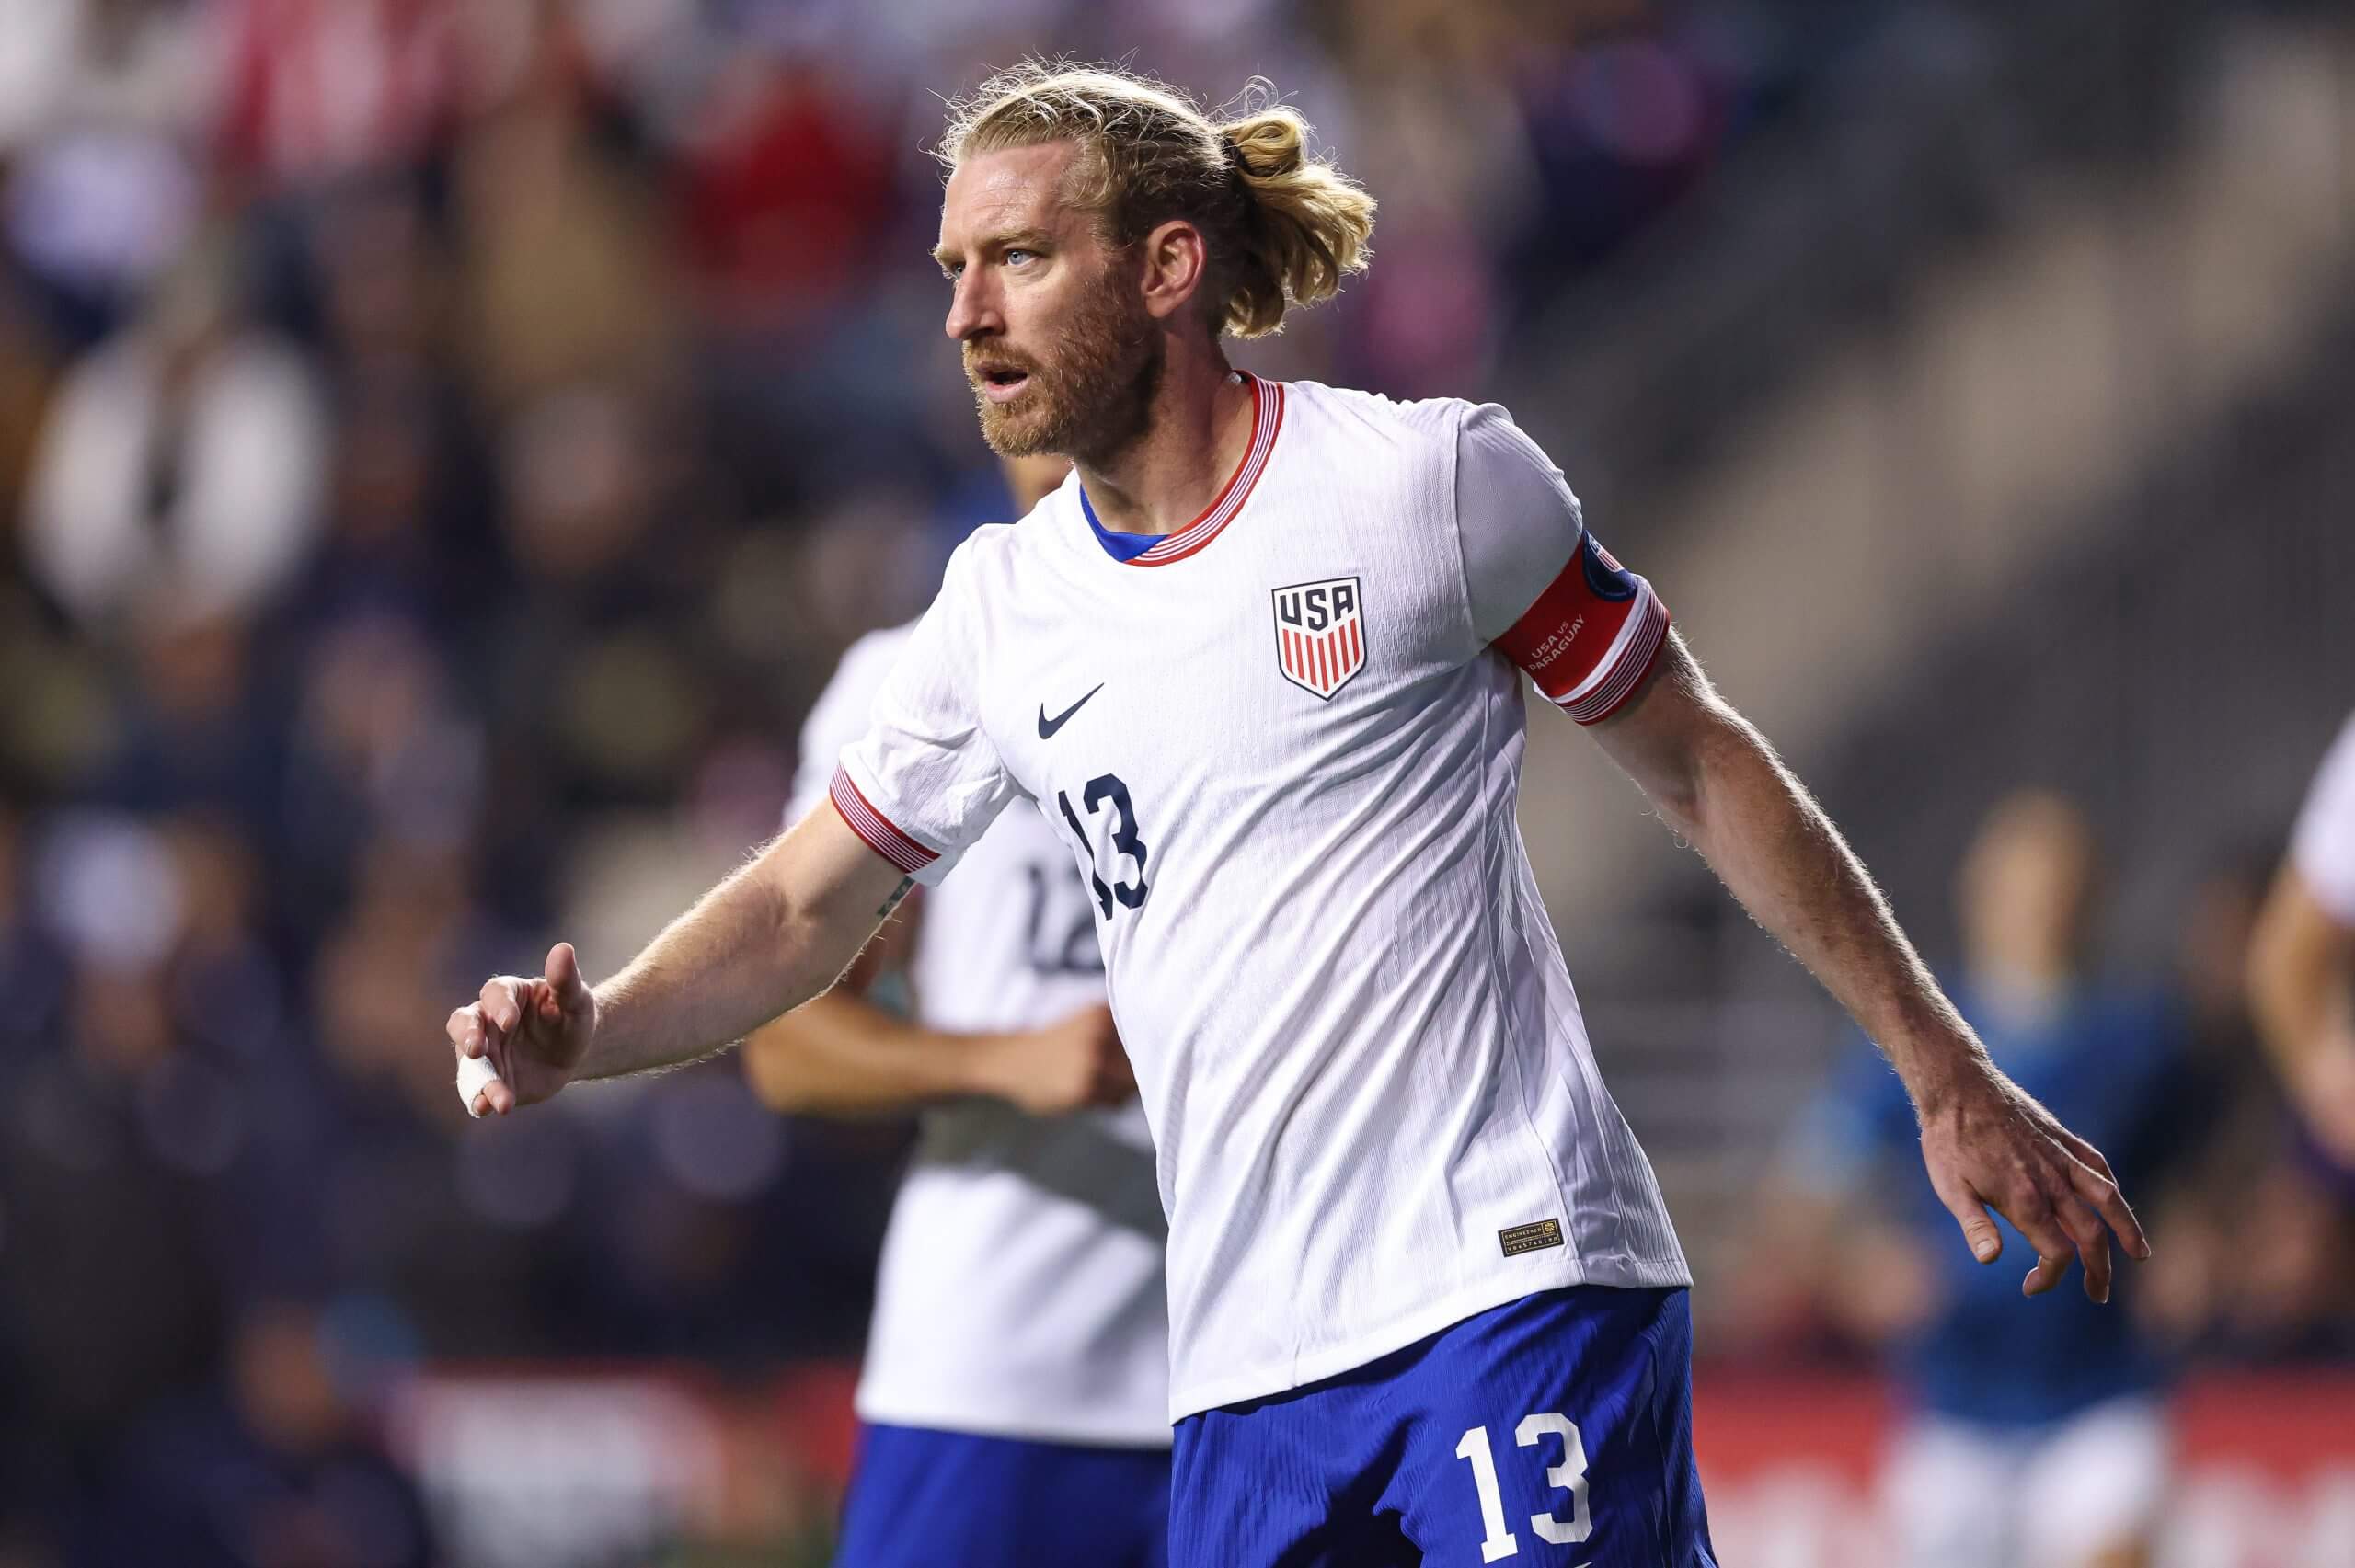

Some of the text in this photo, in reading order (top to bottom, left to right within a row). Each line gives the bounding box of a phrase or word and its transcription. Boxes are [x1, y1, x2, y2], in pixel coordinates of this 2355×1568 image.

[1280, 585, 1354, 631] USA
[1528, 613, 1584, 670] PARAGUAY
[1532, 635, 1558, 658] USA
[1058, 773, 1148, 921] 13
[1455, 1413, 1593, 1564] 13
